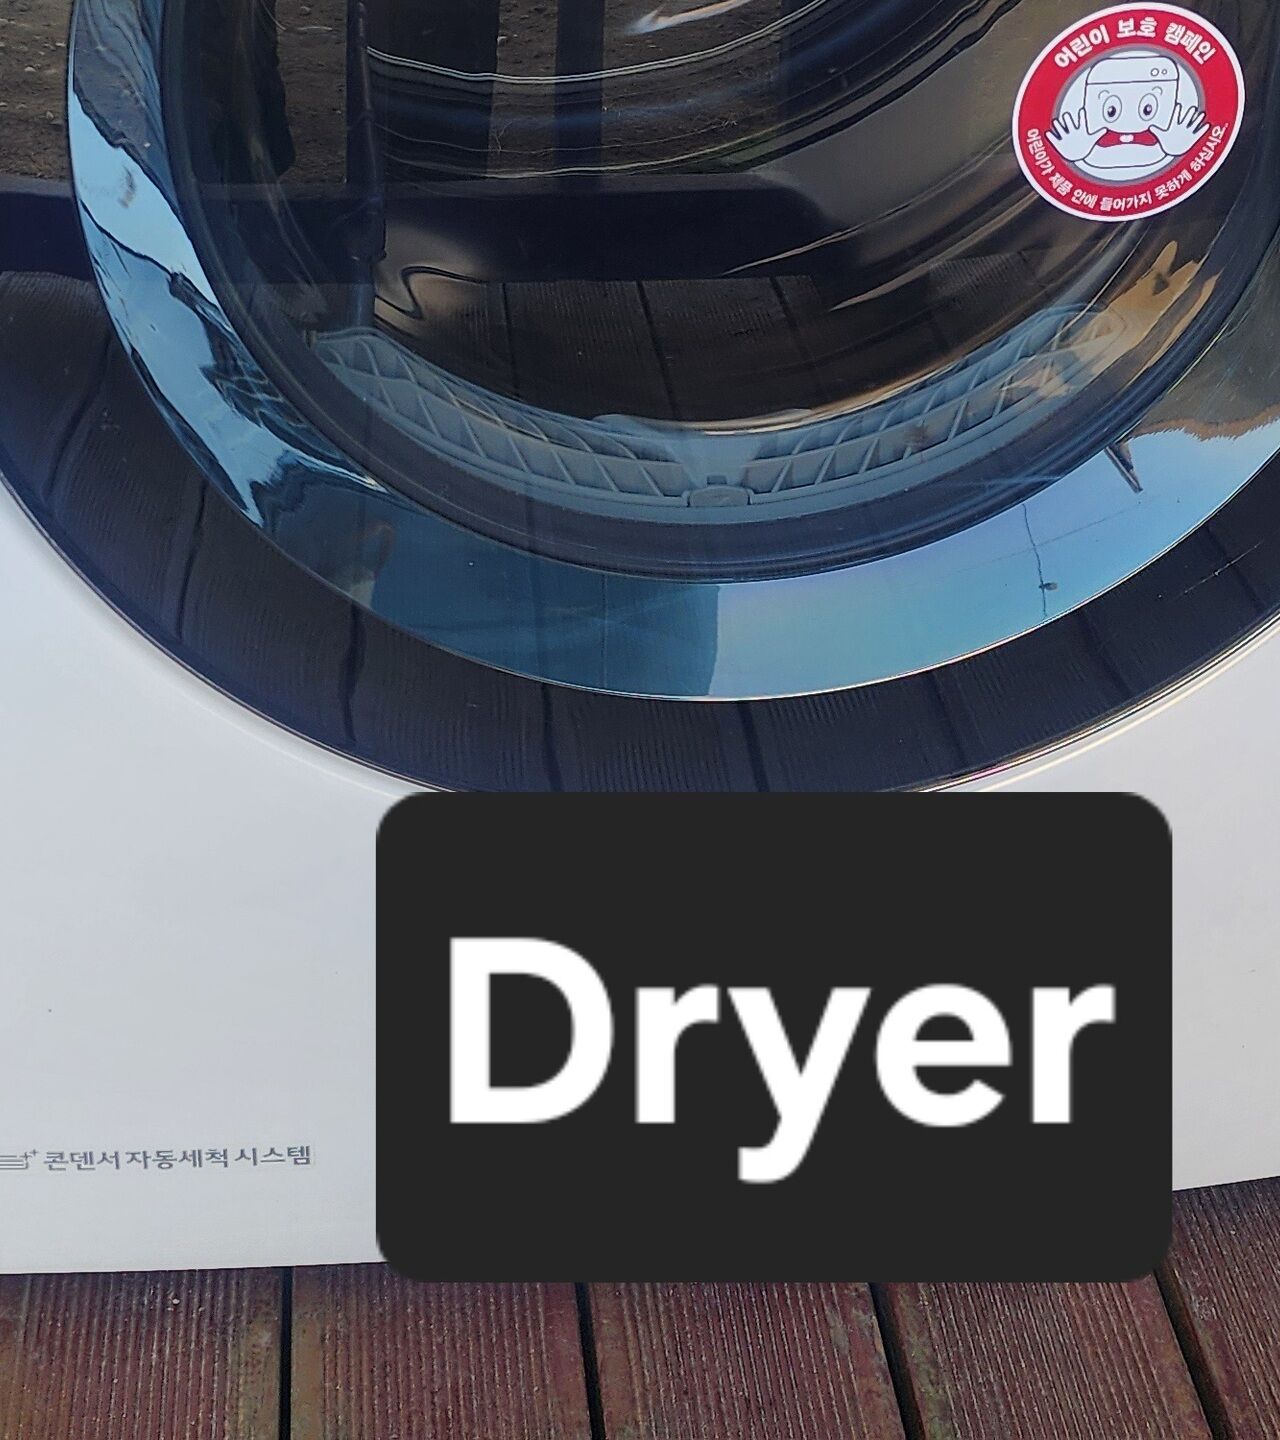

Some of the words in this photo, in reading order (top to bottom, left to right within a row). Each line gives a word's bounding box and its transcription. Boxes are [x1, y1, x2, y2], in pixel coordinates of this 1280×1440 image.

[1053, 24, 1111, 70] 어린이
[1115, 16, 1158, 39] 보호
[1164, 21, 1217, 66] 캠페인
[1026, 127, 1056, 177] 어린이가
[1073, 187, 1098, 210] 안에
[1154, 169, 1194, 200] 못하게
[43, 1150, 121, 1172] 콘덴서
[124, 1148, 229, 1171] 자동세척
[234, 1145, 312, 1168] 시스템
